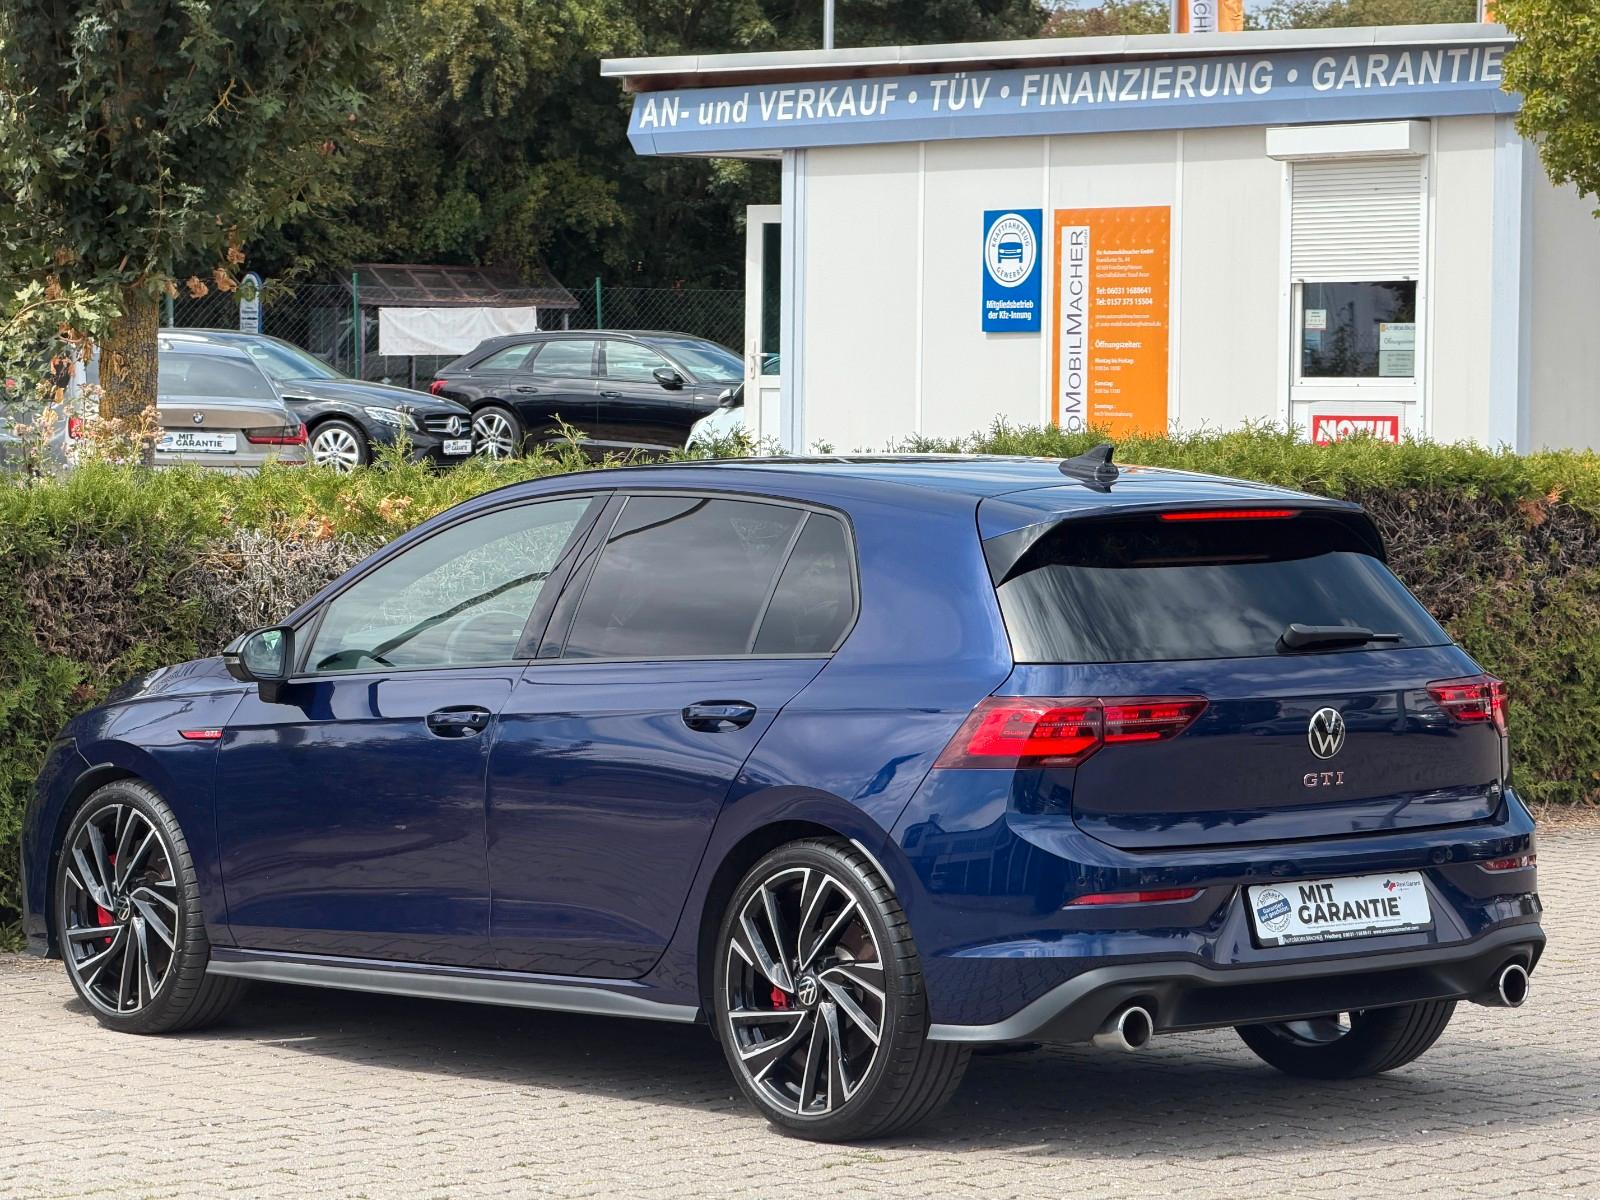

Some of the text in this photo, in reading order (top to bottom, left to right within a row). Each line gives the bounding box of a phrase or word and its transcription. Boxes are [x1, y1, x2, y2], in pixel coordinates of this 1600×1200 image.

[639, 46, 1506, 128] AN- und VERKAUF TÜV FINANZIERUNG GARANTIE
[986, 300, 1034, 310] Mitgliedsbetrieb
[988, 311, 998, 319] der
[1303, 771, 1344, 787] GTI
[1298, 884, 1334, 904] MIT
